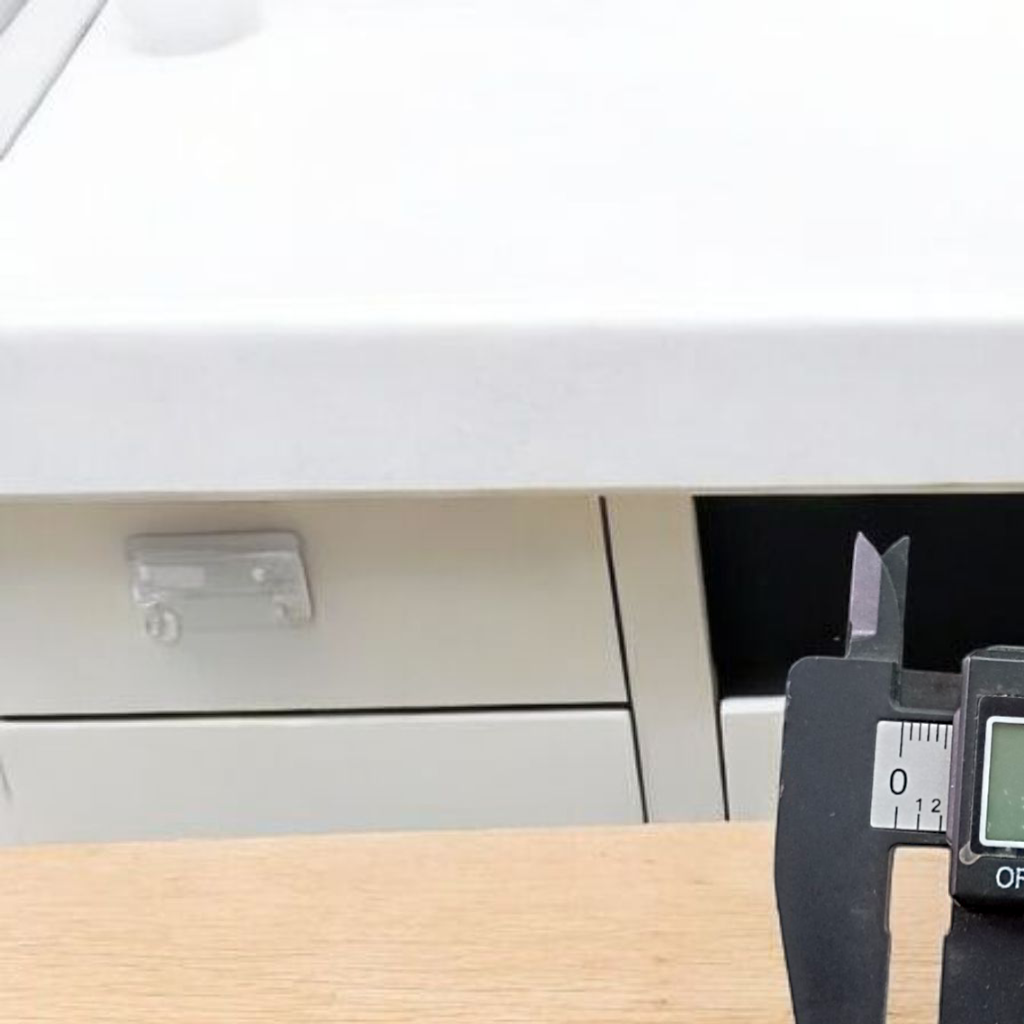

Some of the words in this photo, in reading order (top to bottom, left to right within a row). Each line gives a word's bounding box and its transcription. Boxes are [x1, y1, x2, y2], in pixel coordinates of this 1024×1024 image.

[889, 768, 908, 795] 0
[915, 798, 923, 812] 1
[931, 798, 942, 813] 2
